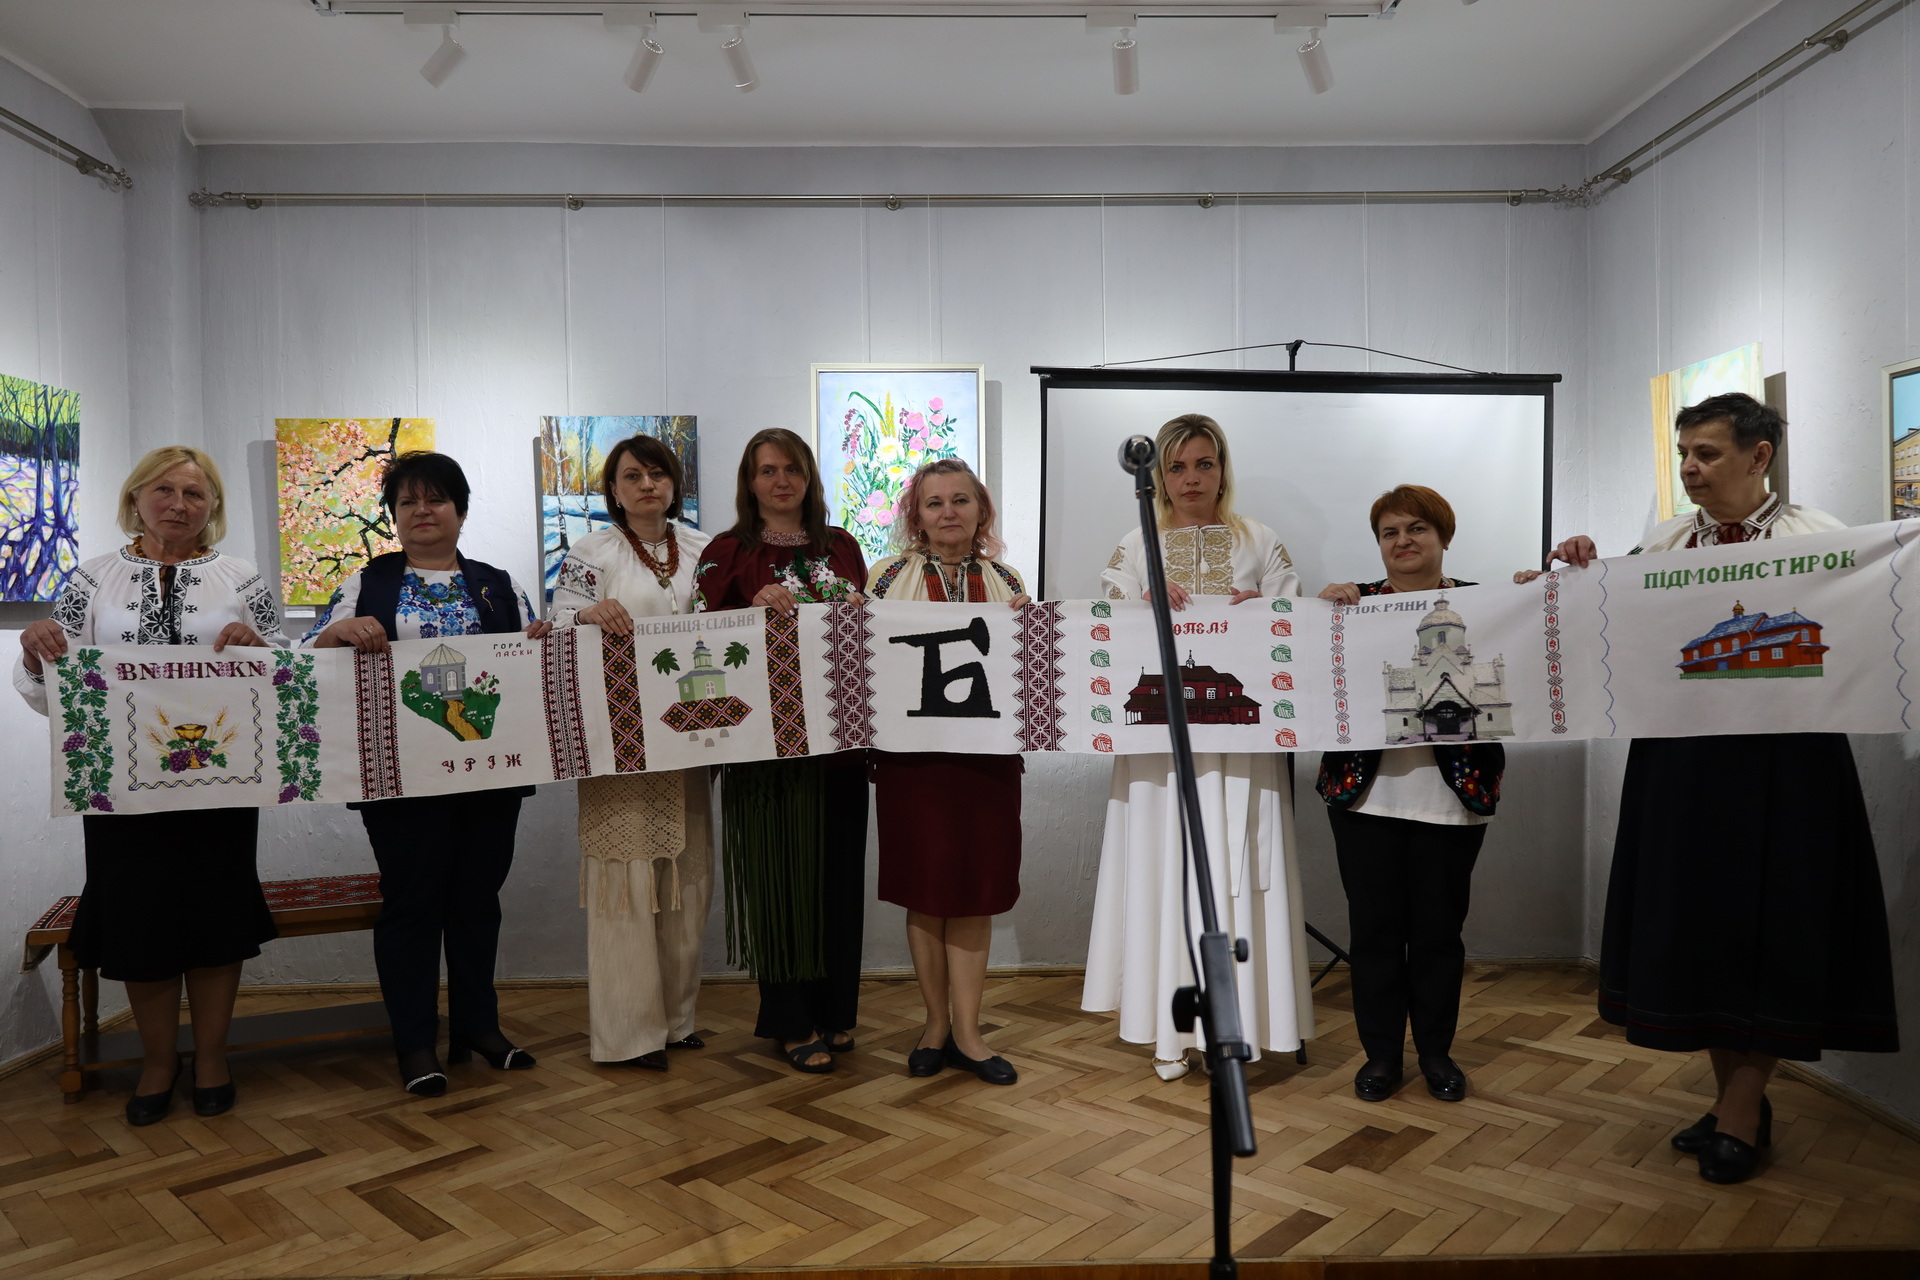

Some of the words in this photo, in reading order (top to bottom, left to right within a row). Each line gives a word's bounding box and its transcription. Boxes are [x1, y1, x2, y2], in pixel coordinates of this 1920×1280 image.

[1345, 600, 1428, 615] МОКРЯНИ
[636, 613, 756, 636] ЯСЕНИЦЯ-СІЛЬНА
[1172, 620, 1228, 635] ОПЕЛІ
[493, 642, 522, 650] ГОРА
[495, 649, 533, 658] ЛАСКИ
